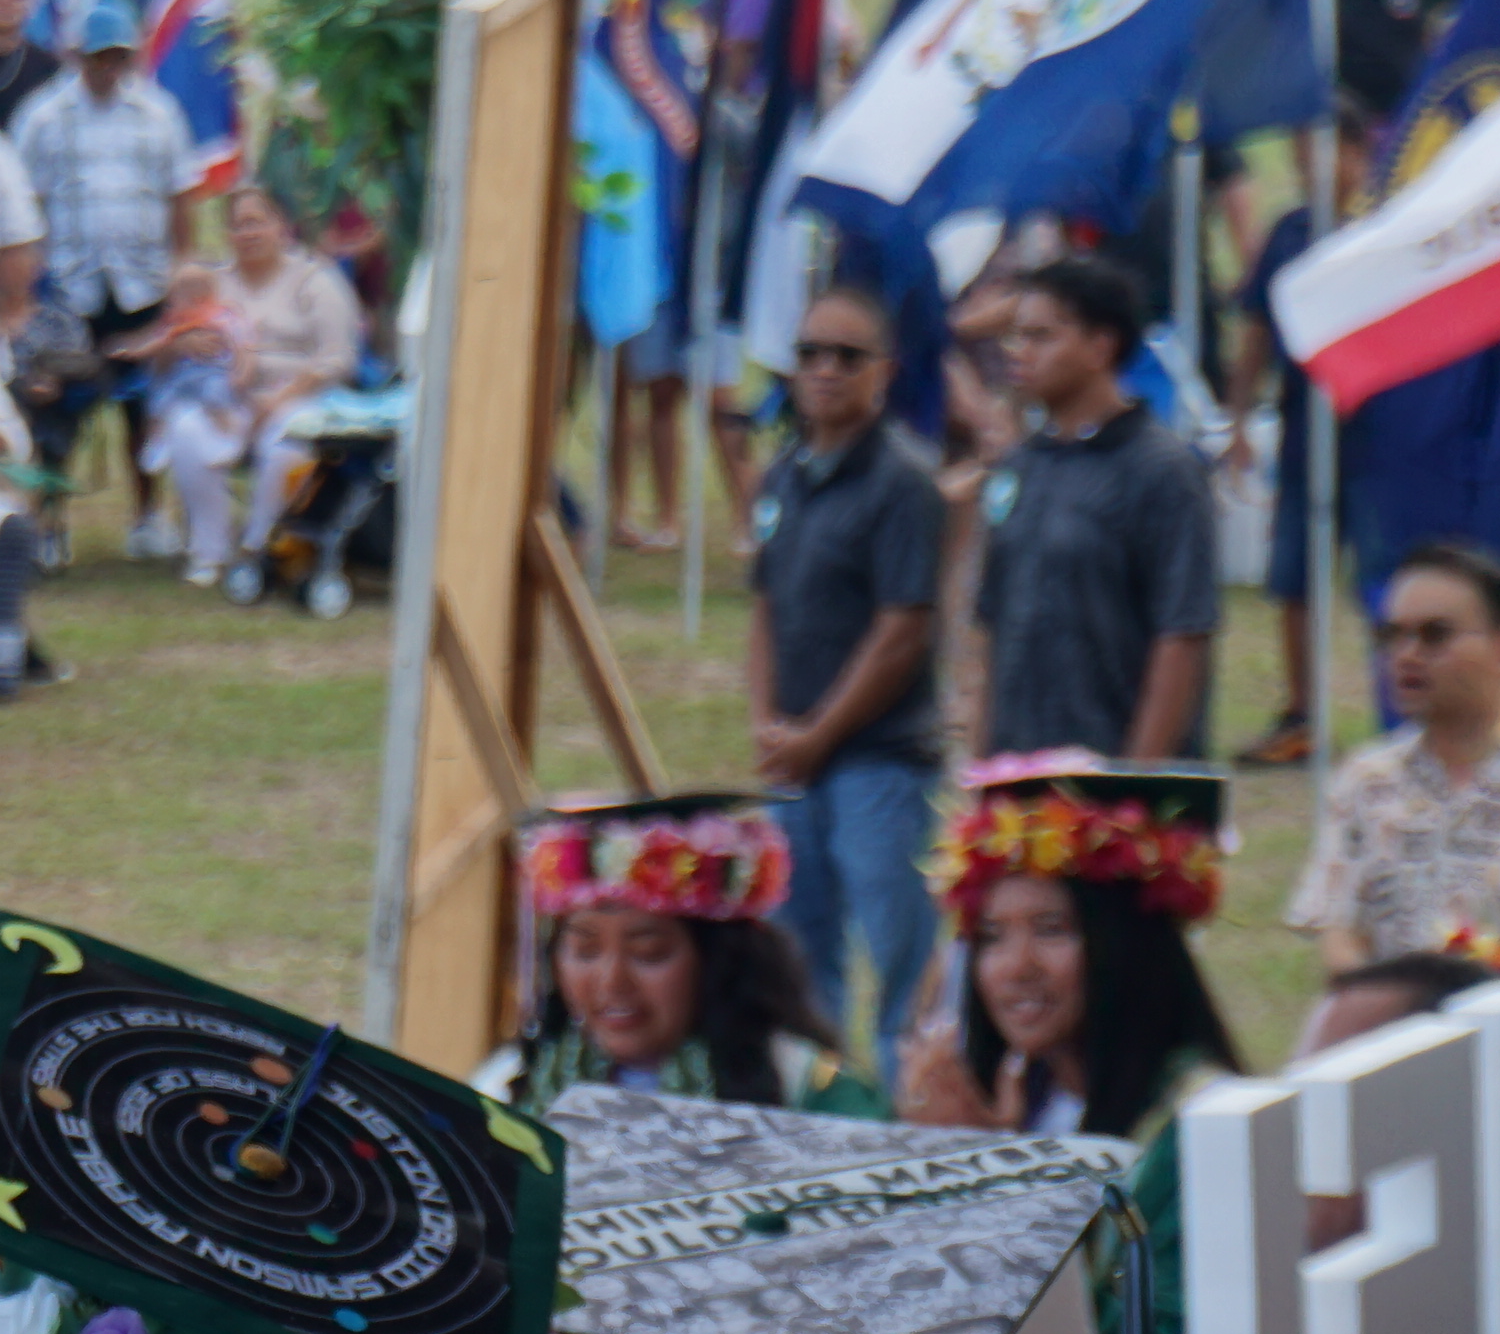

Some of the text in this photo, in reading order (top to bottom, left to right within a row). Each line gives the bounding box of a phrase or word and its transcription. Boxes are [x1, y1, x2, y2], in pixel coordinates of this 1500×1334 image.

[76, 1011, 122, 1043] THE
[127, 1007, 180, 1028] FOR
[155, 1067, 190, 1094] OF
[193, 1067, 283, 1105] LASS
[865, 1138, 1070, 1193] MAYBE
[55, 1082, 458, 1301] JUSTIN DAVID SAMSON AFABLE
[562, 1223, 747, 1270] OULD
